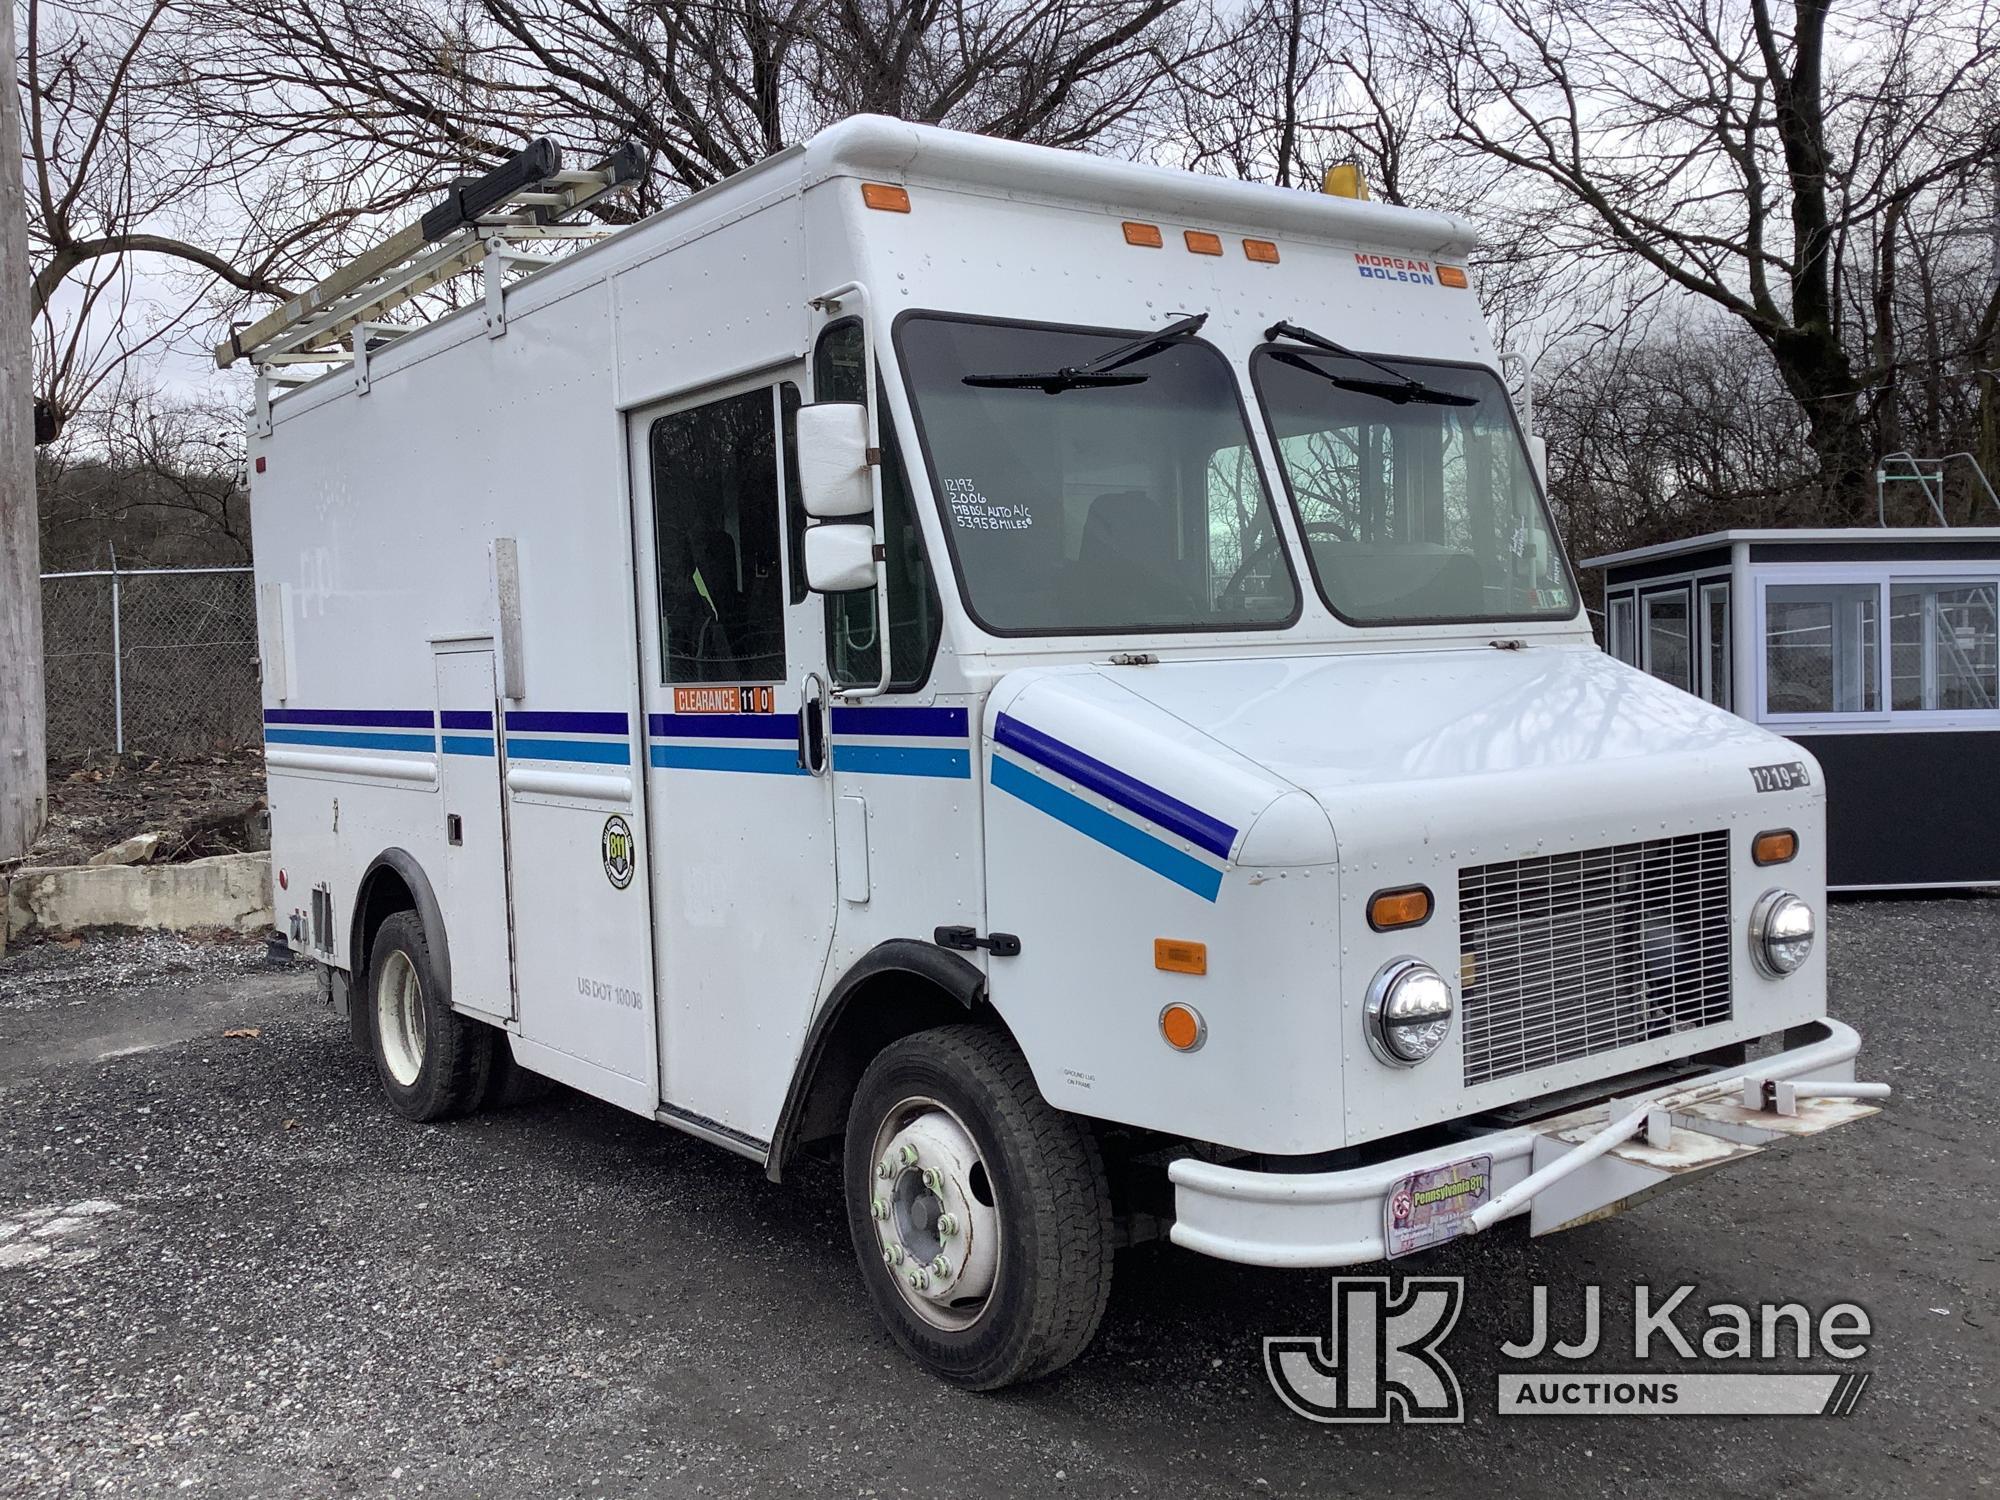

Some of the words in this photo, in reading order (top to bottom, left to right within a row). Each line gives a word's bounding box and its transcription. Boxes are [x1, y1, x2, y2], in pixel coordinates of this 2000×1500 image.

[1354, 253, 1430, 272] MORGAN
[1373, 268, 1434, 285] OLSON
[944, 479, 974, 491] 12193
[950, 492, 986, 504] 2006
[987, 506, 1011, 518] AUTO
[678, 690, 735, 711] CLEARANCE
[1753, 762, 1809, 791] 1219-3
[609, 832, 627, 860] 811
[578, 977, 591, 996] US
[592, 981, 613, 1002] DOT
[1414, 1179, 1470, 1207] Pennsylvania
[1470, 1175, 1484, 1191] 811
